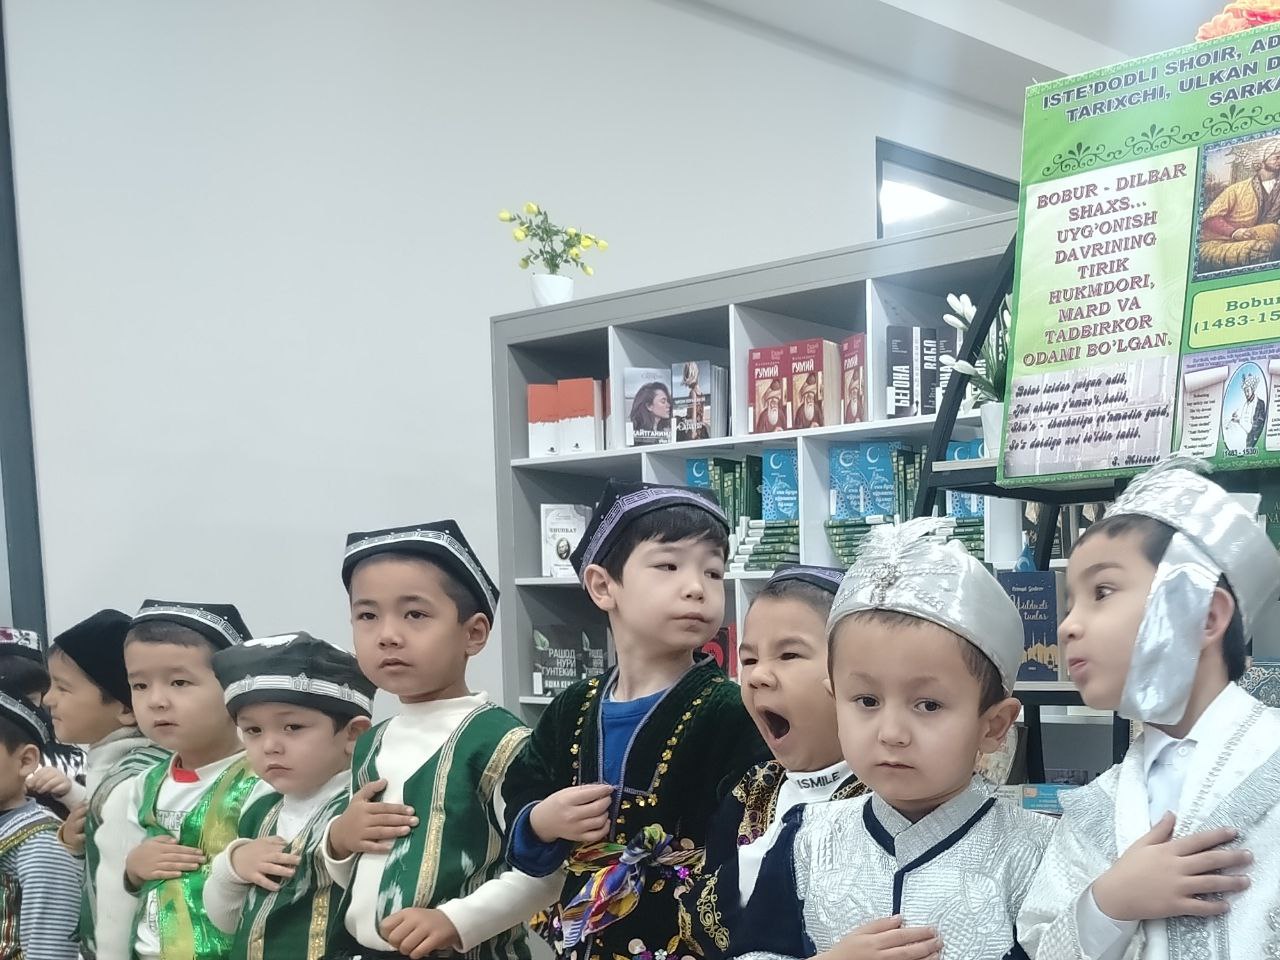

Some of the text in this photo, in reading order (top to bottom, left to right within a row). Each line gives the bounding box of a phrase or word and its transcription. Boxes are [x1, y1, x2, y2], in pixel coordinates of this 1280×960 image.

[1042, 66, 1157, 110] ISTE'DODLI
[1164, 46, 1242, 76] SHOIR,
[1066, 84, 1171, 123] TARIXCHI,
[1178, 60, 1259, 93] ULKAN
[1036, 183, 1098, 209] BOBUR
[1115, 163, 1187, 192] DILBAR
[1068, 196, 1147, 222] SHAXS...
[1057, 210, 1158, 244] UYG'ONISH
[1055, 232, 1157, 265] DAVRINING
[1078, 257, 1129, 280] TIRIK
[1049, 274, 1155, 304] HUKMDORI,
[1058, 296, 1141, 323] MARD VA
[1045, 314, 1153, 345] TADBIRKOR
[1023, 346, 1081, 367] ODAMI
[1086, 332, 1172, 358] BO'LGAN.
[754, 365, 779, 378] РУМИЙ
[791, 358, 814, 374] РУМИЙ
[548, 648, 576, 659] РАШОД
[556, 658, 576, 668] НУРИ
[541, 667, 577, 676] ГУНТЕКИН
